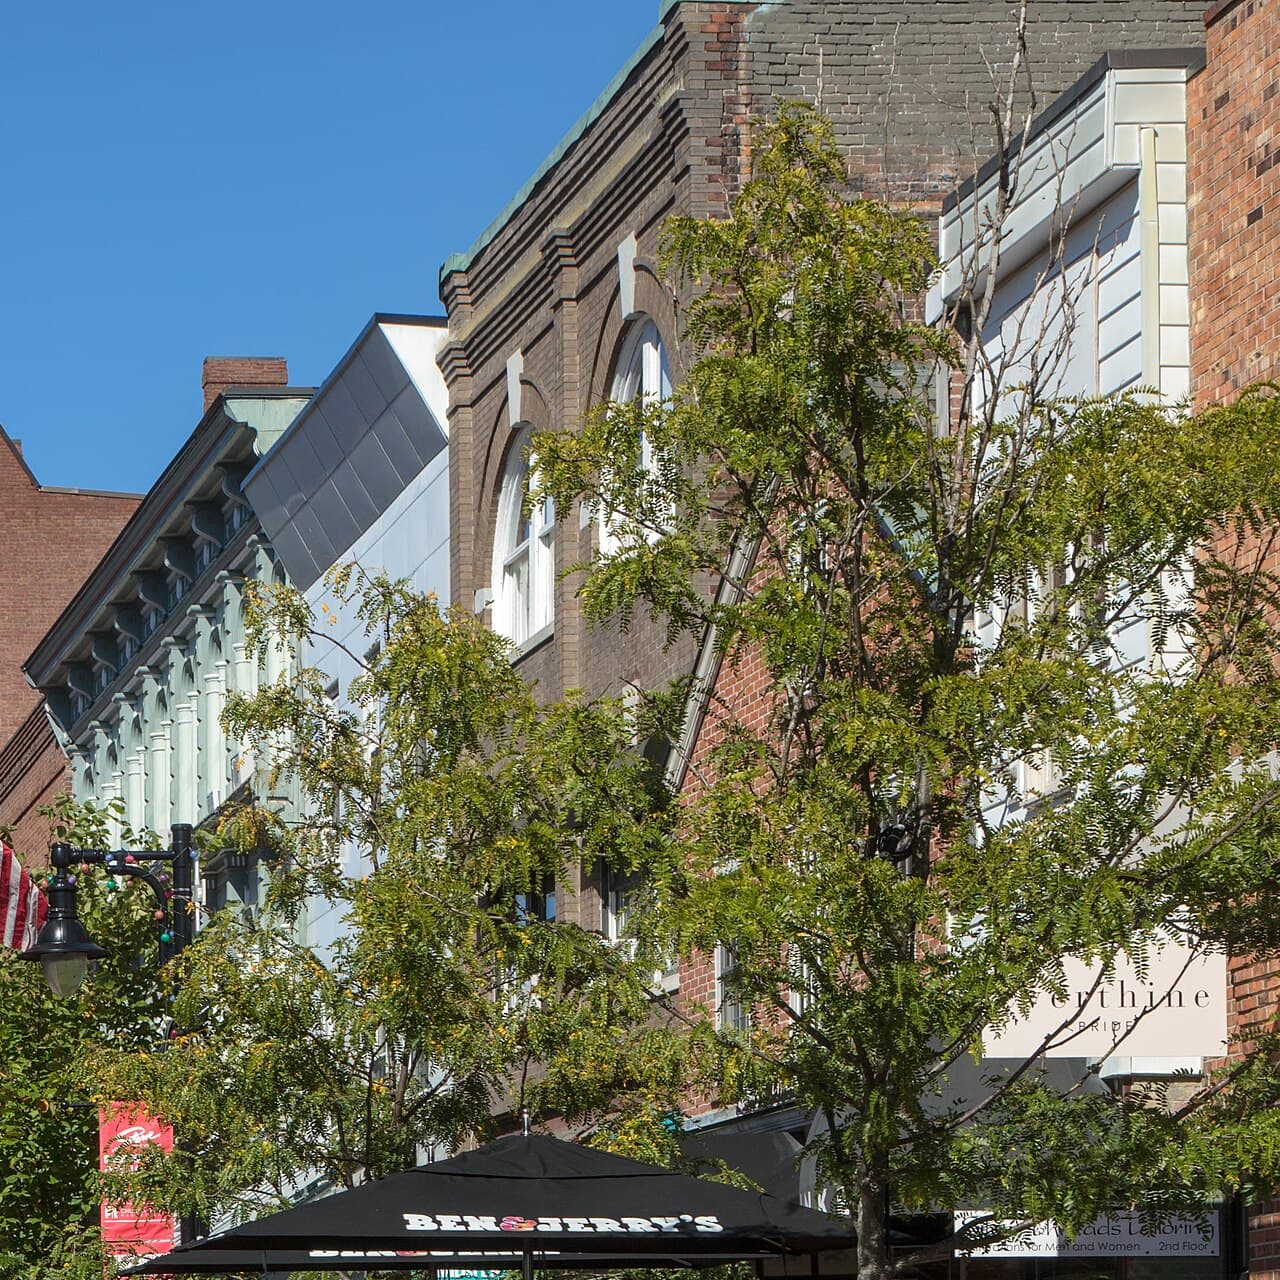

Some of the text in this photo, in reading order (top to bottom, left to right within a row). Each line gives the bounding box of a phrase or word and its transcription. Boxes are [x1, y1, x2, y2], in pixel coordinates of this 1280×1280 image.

[1047, 979, 1210, 1009] erthine
[1098, 1241, 1141, 1252] Women
[1159, 1241, 1179, 1252] 2nd
[1182, 1241, 1208, 1252] Floor
